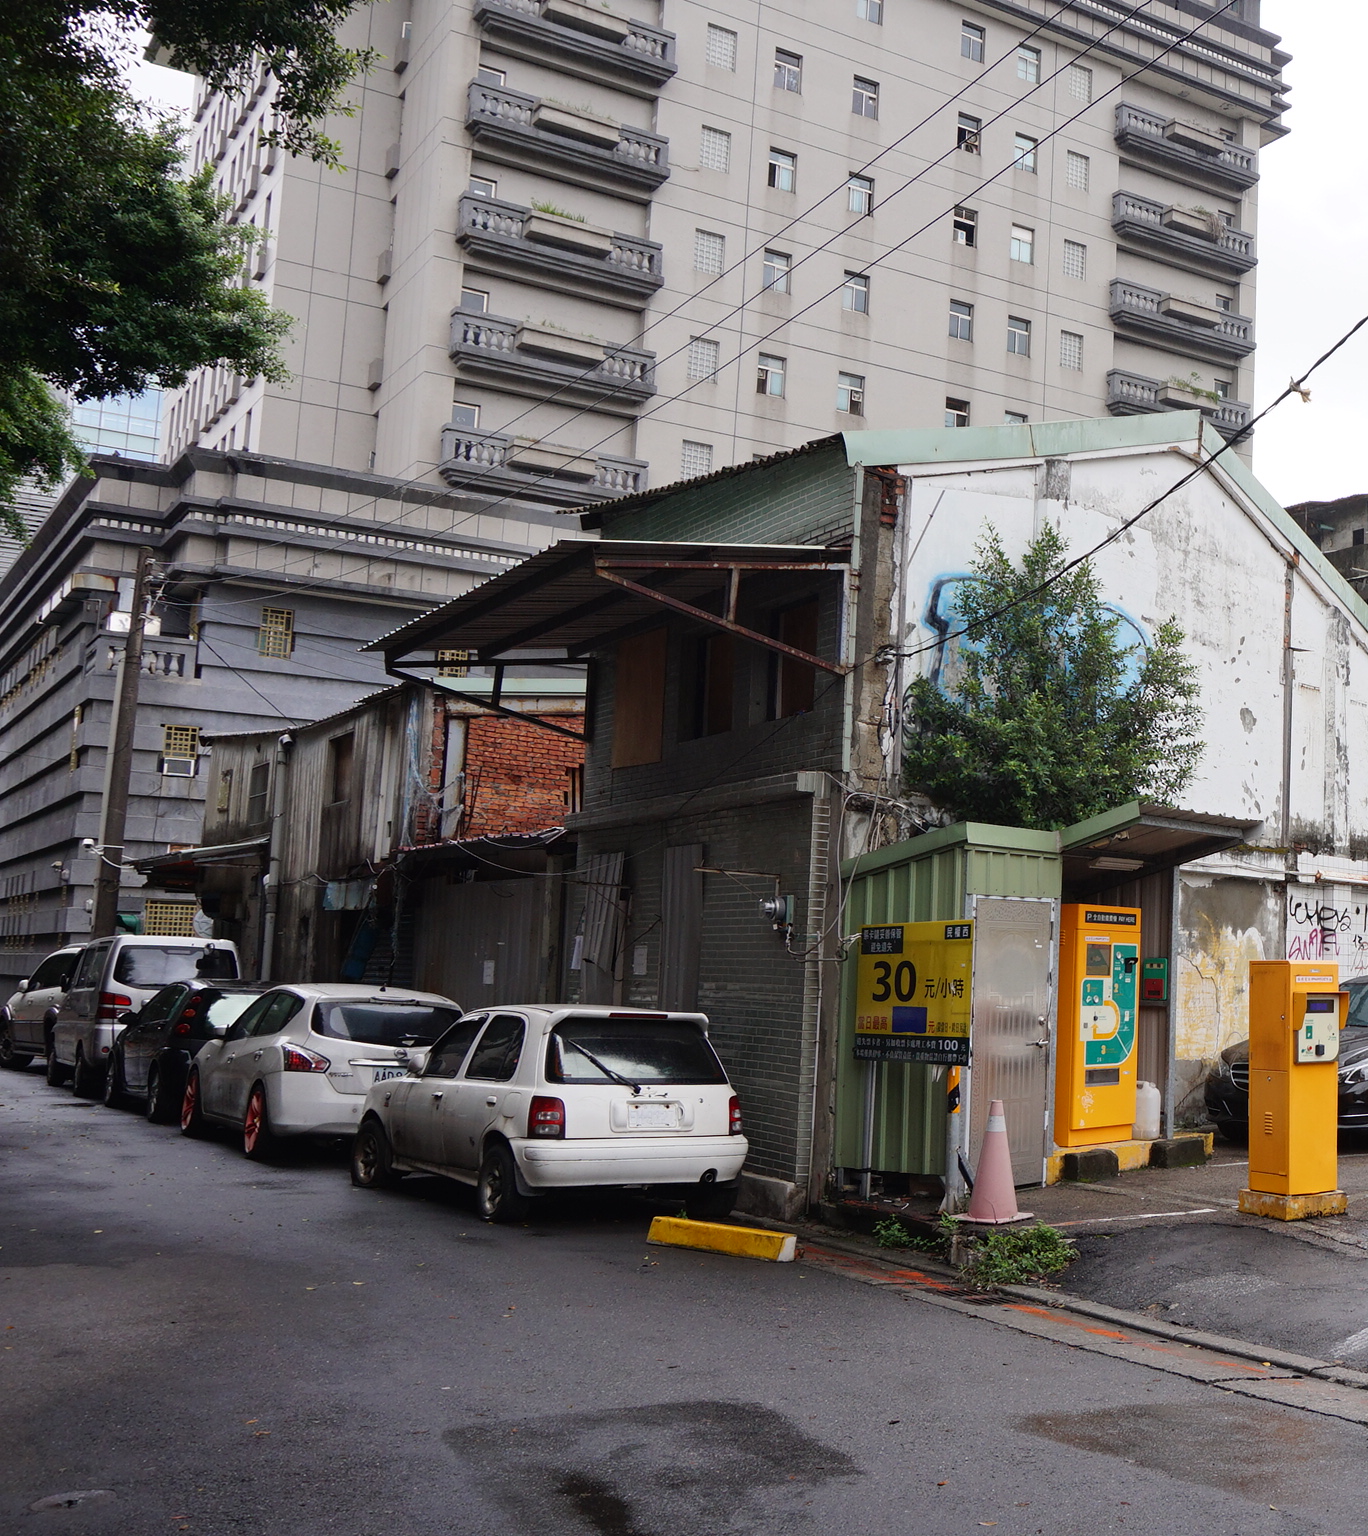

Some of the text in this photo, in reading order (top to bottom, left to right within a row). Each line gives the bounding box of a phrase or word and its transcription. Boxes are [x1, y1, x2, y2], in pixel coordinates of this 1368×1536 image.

[872, 961, 917, 1003] 30
[857, 1016, 888, 1030] 當日最高
[938, 1039, 958, 1051] 100
